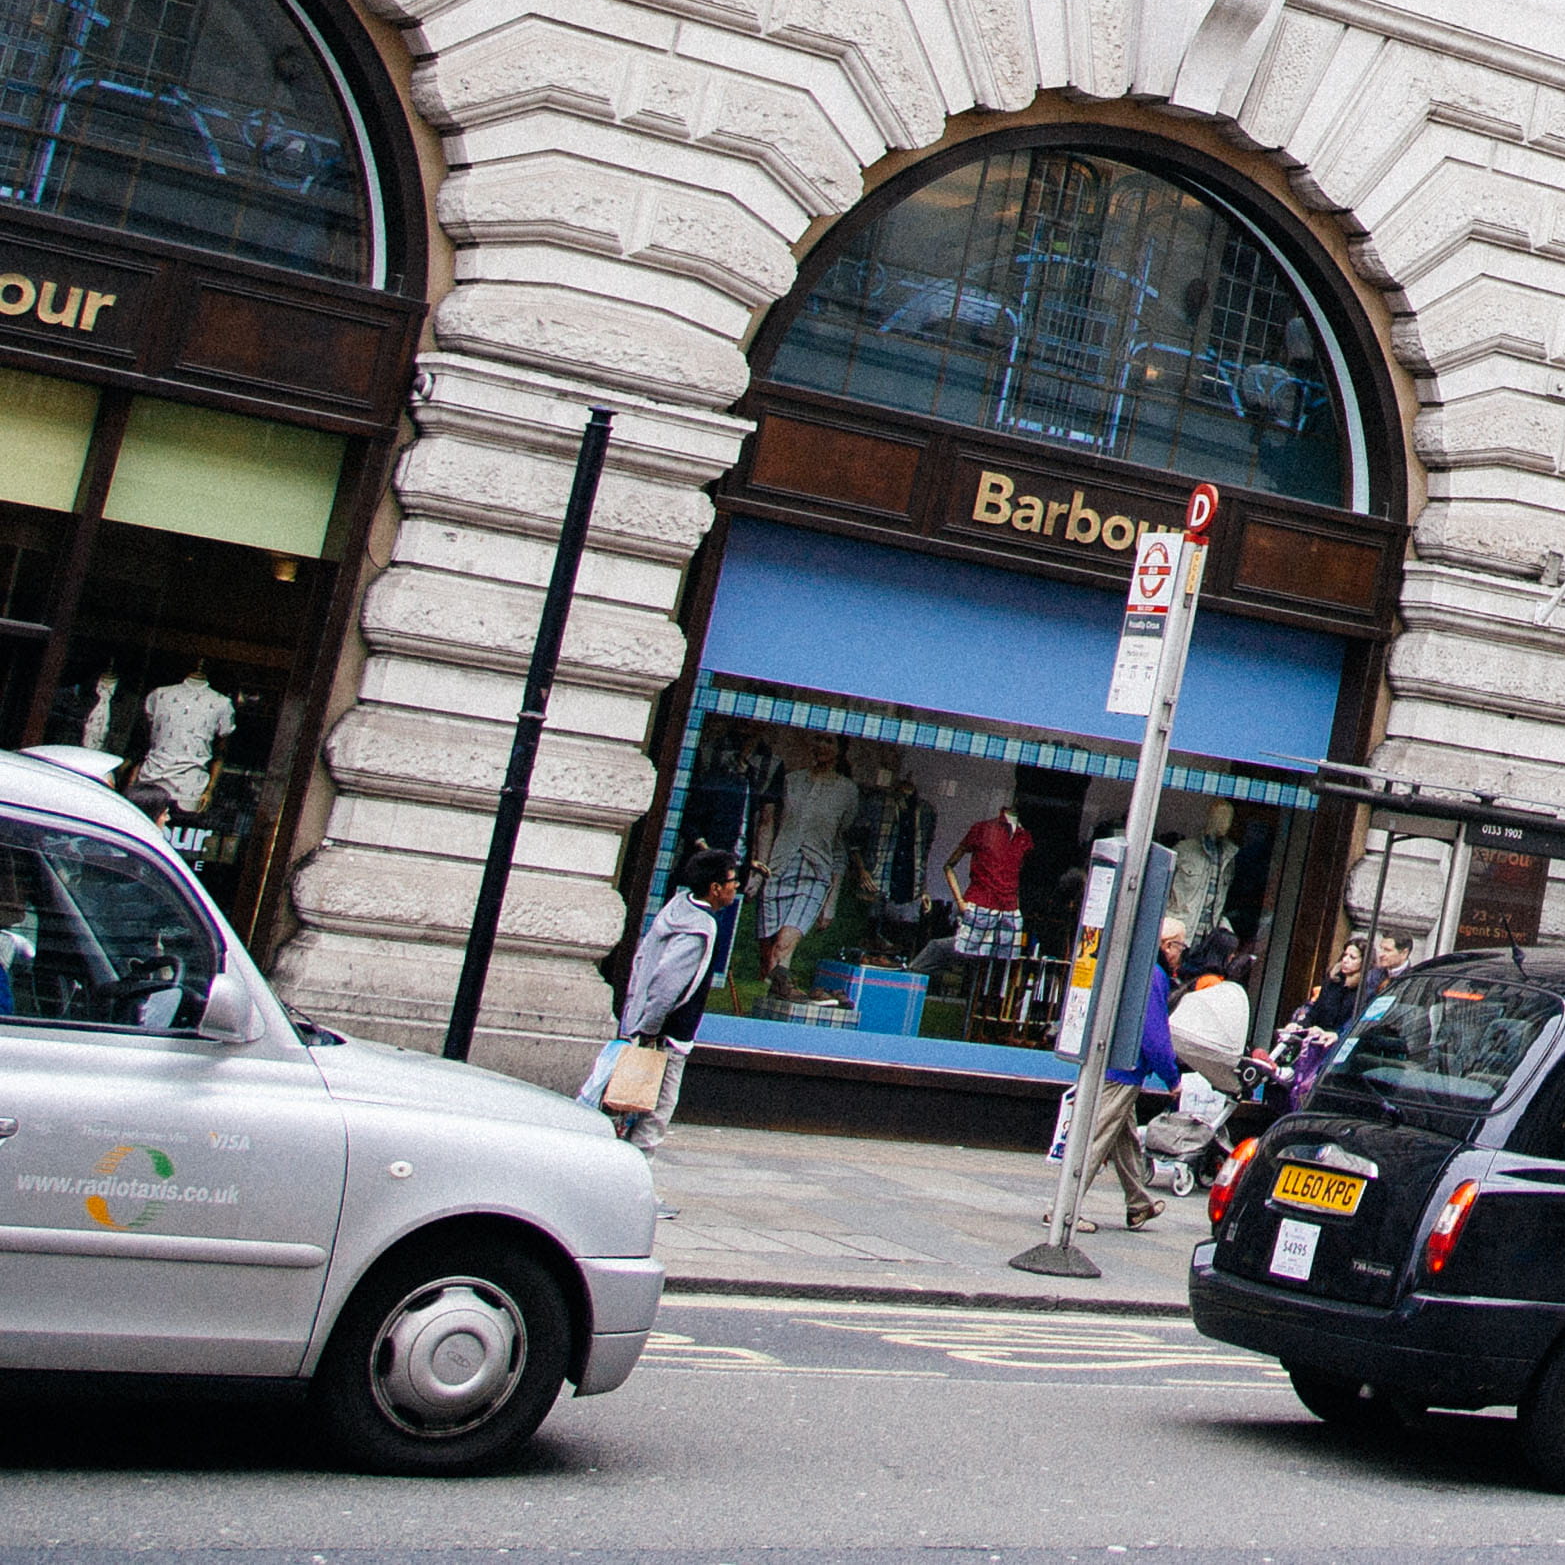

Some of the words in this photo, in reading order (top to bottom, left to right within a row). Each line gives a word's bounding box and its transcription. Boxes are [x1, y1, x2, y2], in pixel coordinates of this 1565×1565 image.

[1190, 493, 1210, 527] D
[1482, 824, 1502, 836] 0133
[1504, 828, 1523, 840] 1902
[208, 1131, 251, 1151] VISA
[15, 1173, 241, 1205] www.radiotaxis.co.uk
[1282, 1170, 1324, 1199] LL60
[1322, 1177, 1356, 1206] KPG
[1282, 1240, 1308, 1257] 54295
